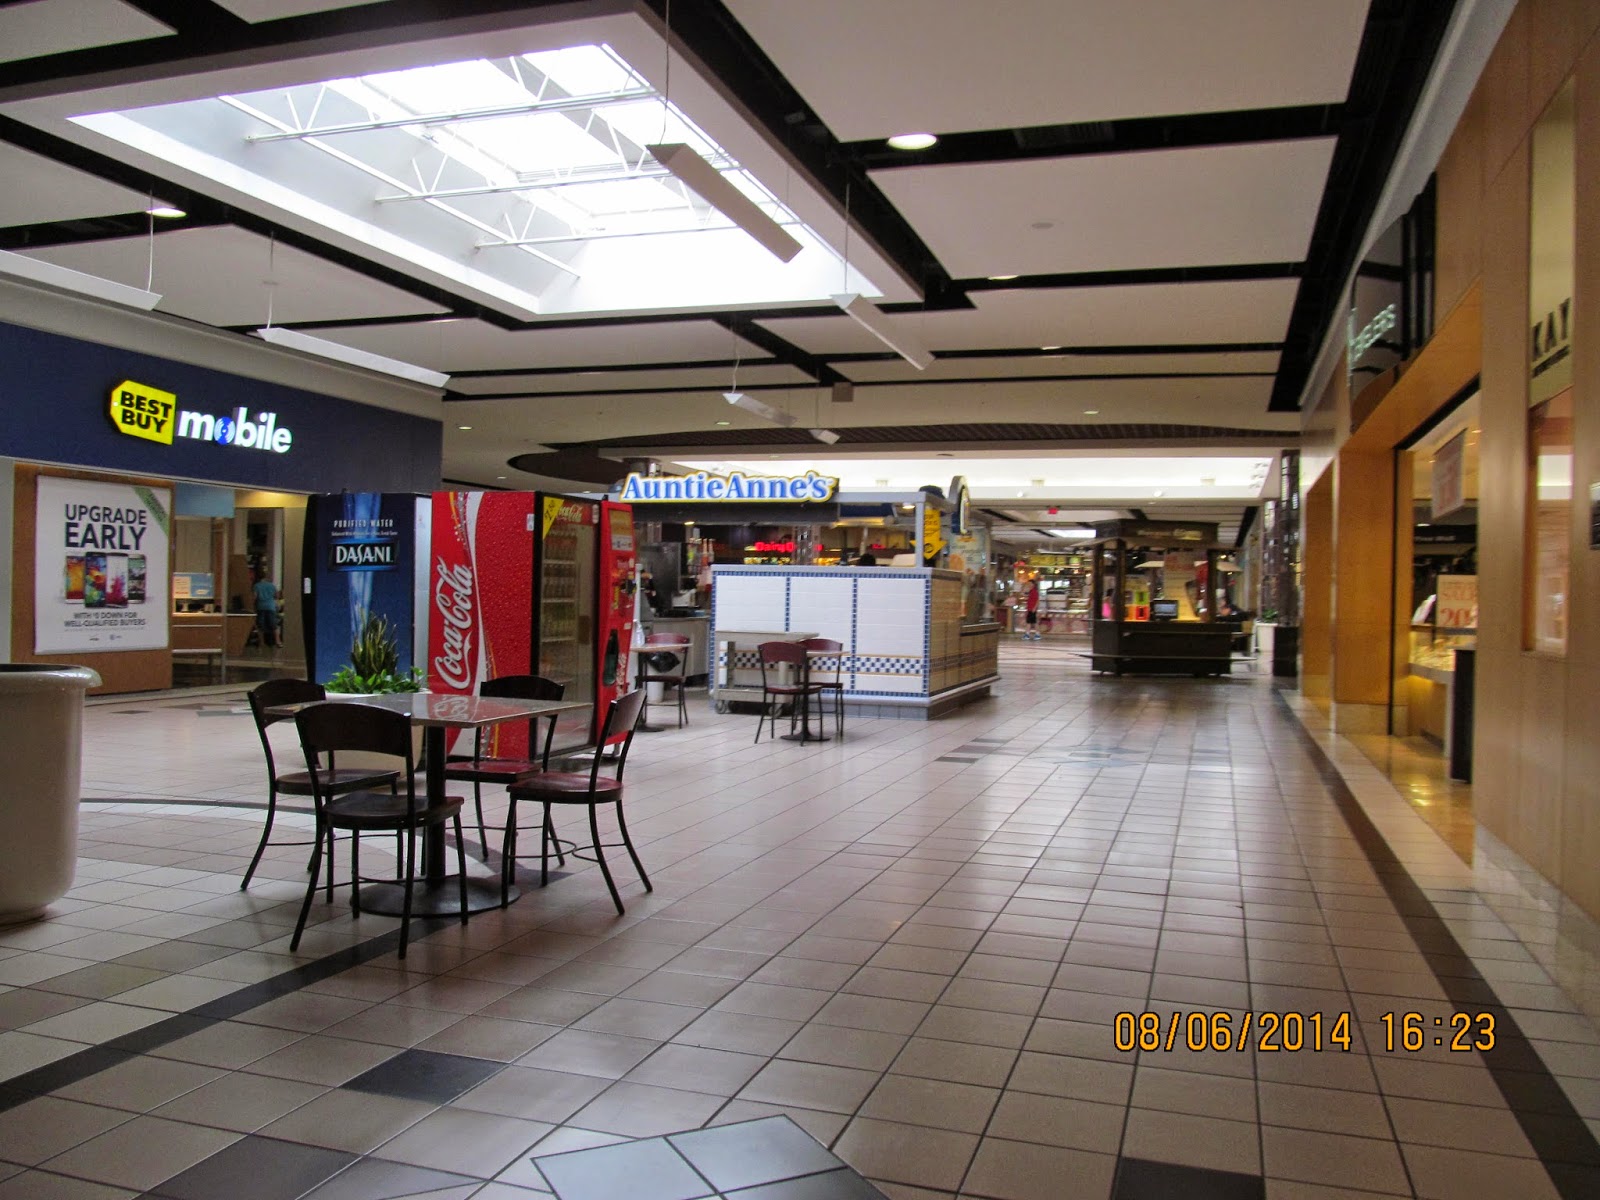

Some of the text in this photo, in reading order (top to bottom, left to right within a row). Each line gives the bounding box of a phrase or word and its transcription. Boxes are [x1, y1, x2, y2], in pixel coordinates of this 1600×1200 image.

[1531, 297, 1571, 361] KAY
[120, 390, 173, 418] BEST
[121, 409, 169, 434] BUY
[177, 406, 293, 453] mobile
[623, 473, 828, 499] Auntie Anne's
[65, 503, 147, 525] UPGRADE
[333, 519, 394, 528] PURIFIED WATER
[65, 522, 147, 551] EARLY
[336, 543, 392, 566] DASANI
